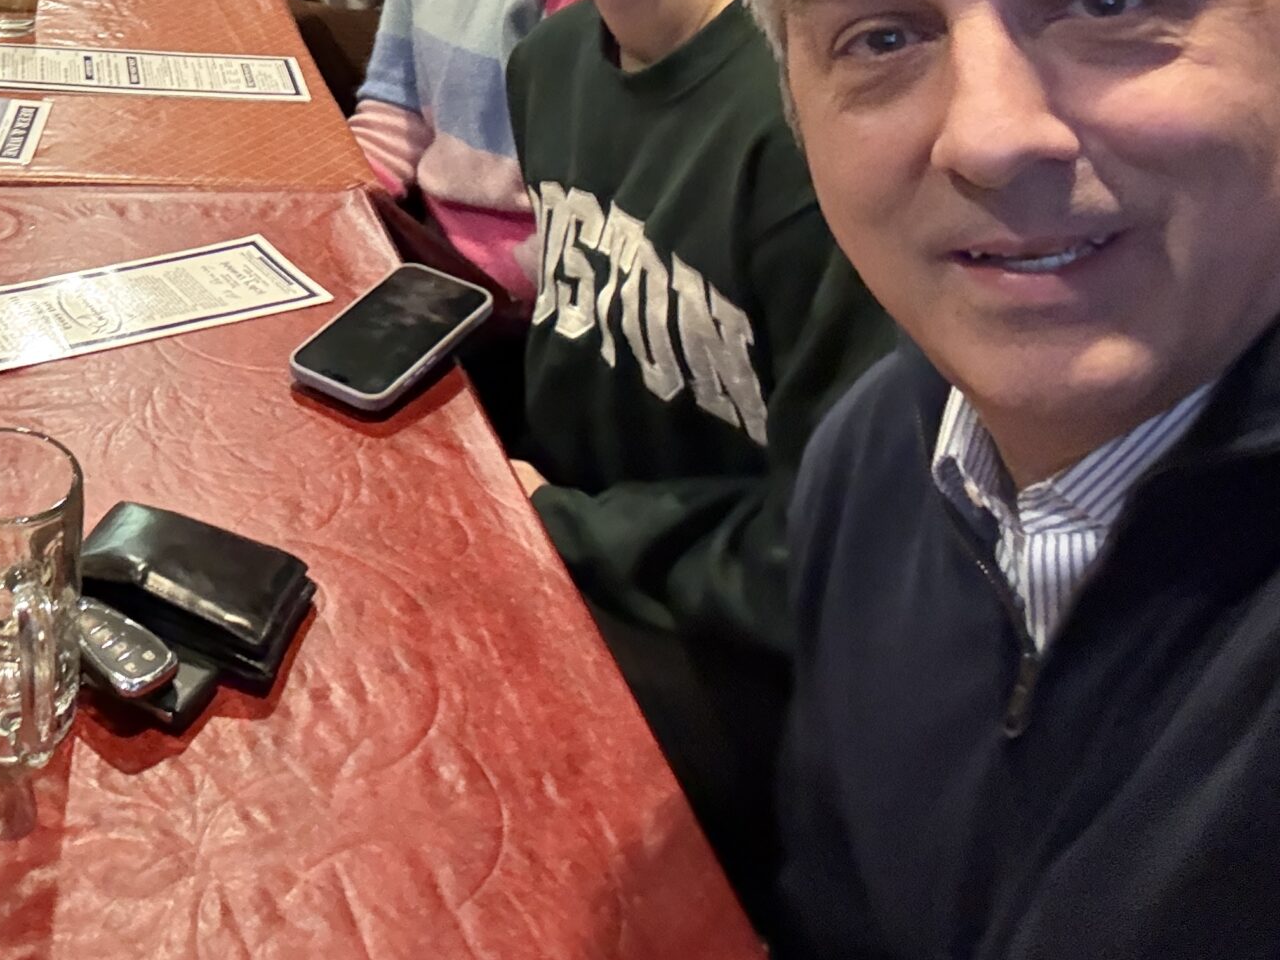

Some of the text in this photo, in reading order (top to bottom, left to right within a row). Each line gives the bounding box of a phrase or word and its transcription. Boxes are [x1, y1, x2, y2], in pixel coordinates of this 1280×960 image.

[13, 108, 36, 129] BEER
[0, 137, 24, 158] WINE
[528, 180, 768, 447] OSTON
